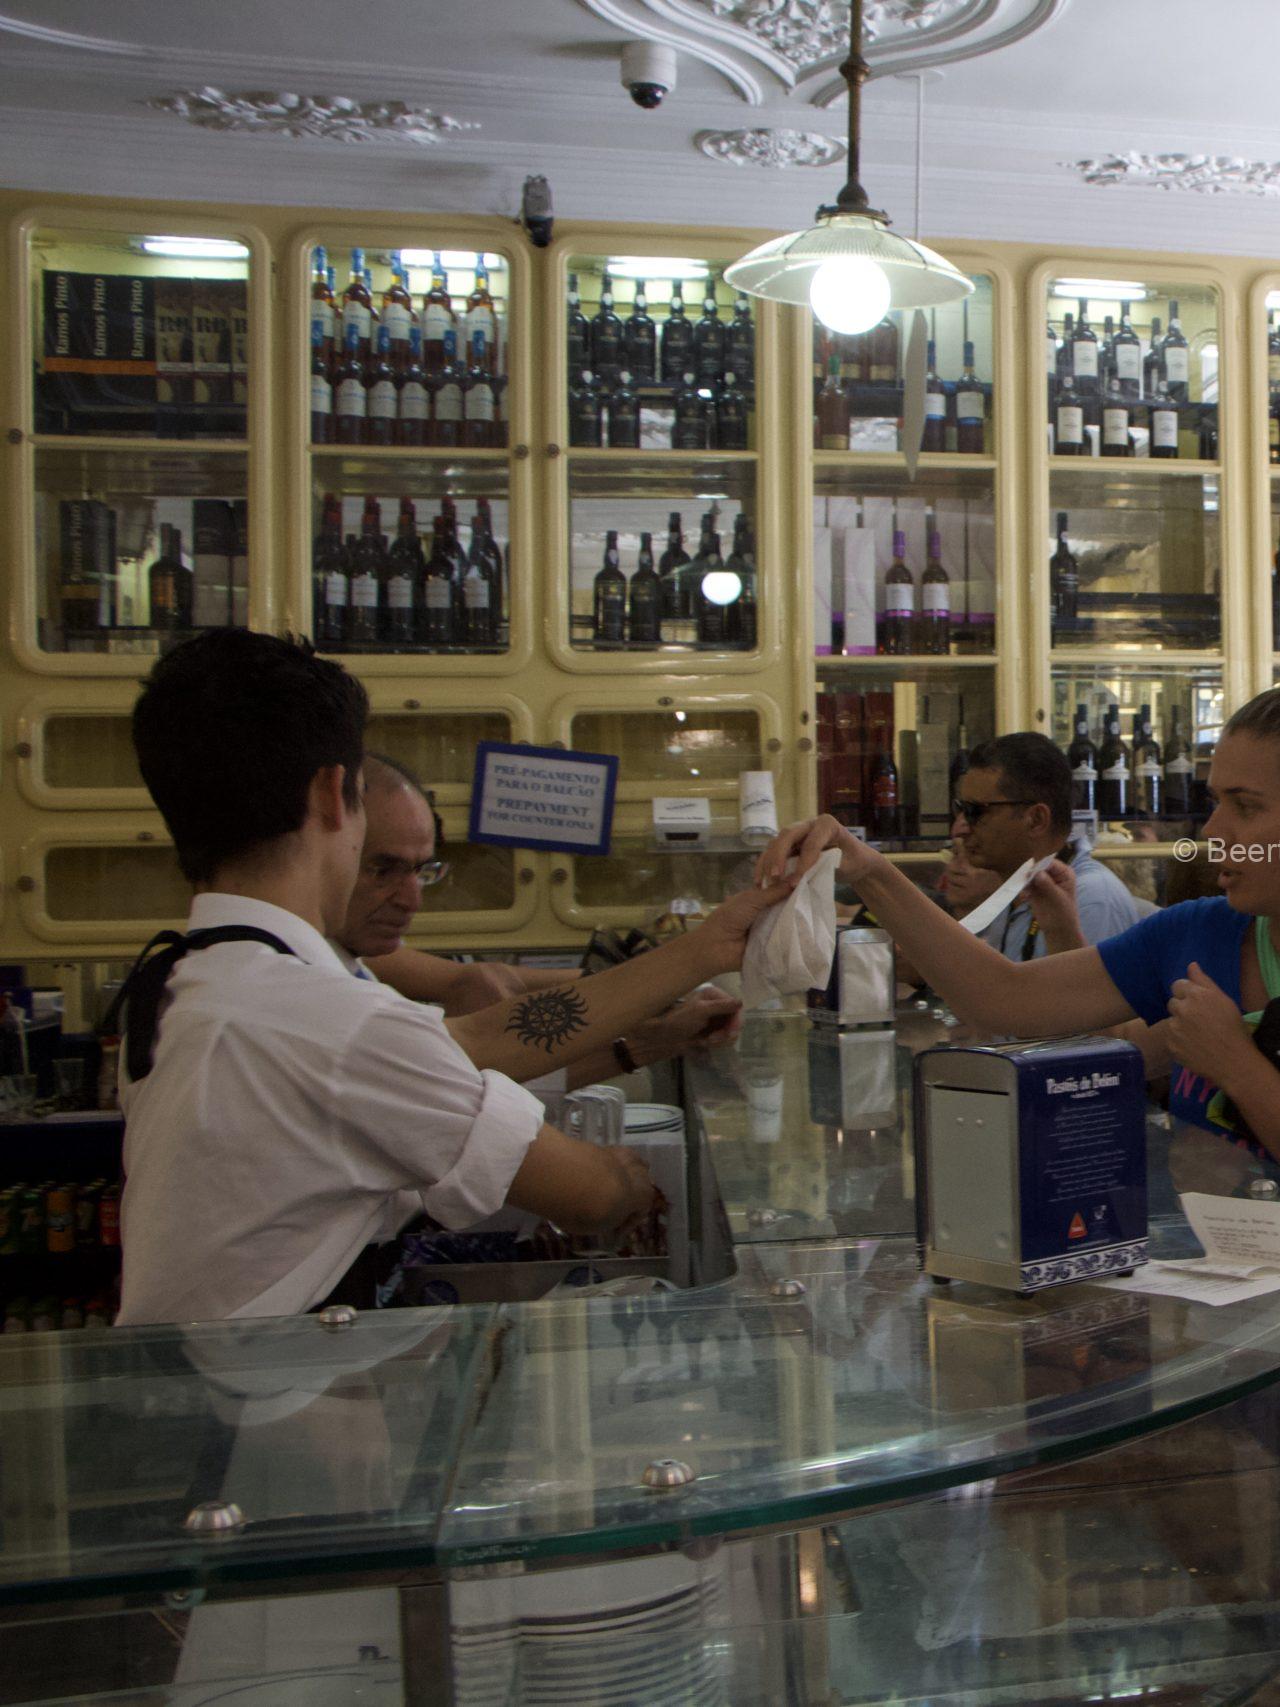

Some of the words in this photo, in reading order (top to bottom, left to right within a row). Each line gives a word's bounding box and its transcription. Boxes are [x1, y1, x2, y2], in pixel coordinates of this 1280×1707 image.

[54, 275, 69, 309] Pinto
[93, 277, 105, 311] Pinto
[131, 279, 143, 313] Pinto
[55, 312, 69, 354] Ramos
[94, 314, 106, 357] Ramos
[131, 316, 144, 358] Ramos
[496, 778, 528, 790] PARA
[531, 782, 541, 792] O
[488, 809, 509, 821] FOR
[512, 814, 564, 827] COUNTER
[566, 819, 594, 831] ONLY
[497, 798, 591, 817] PREPAYMENT
[1046, 1077, 1079, 1094] Pastéis
[1079, 1076, 1091, 1091] de
[1091, 1072, 1119, 1089] Belém
